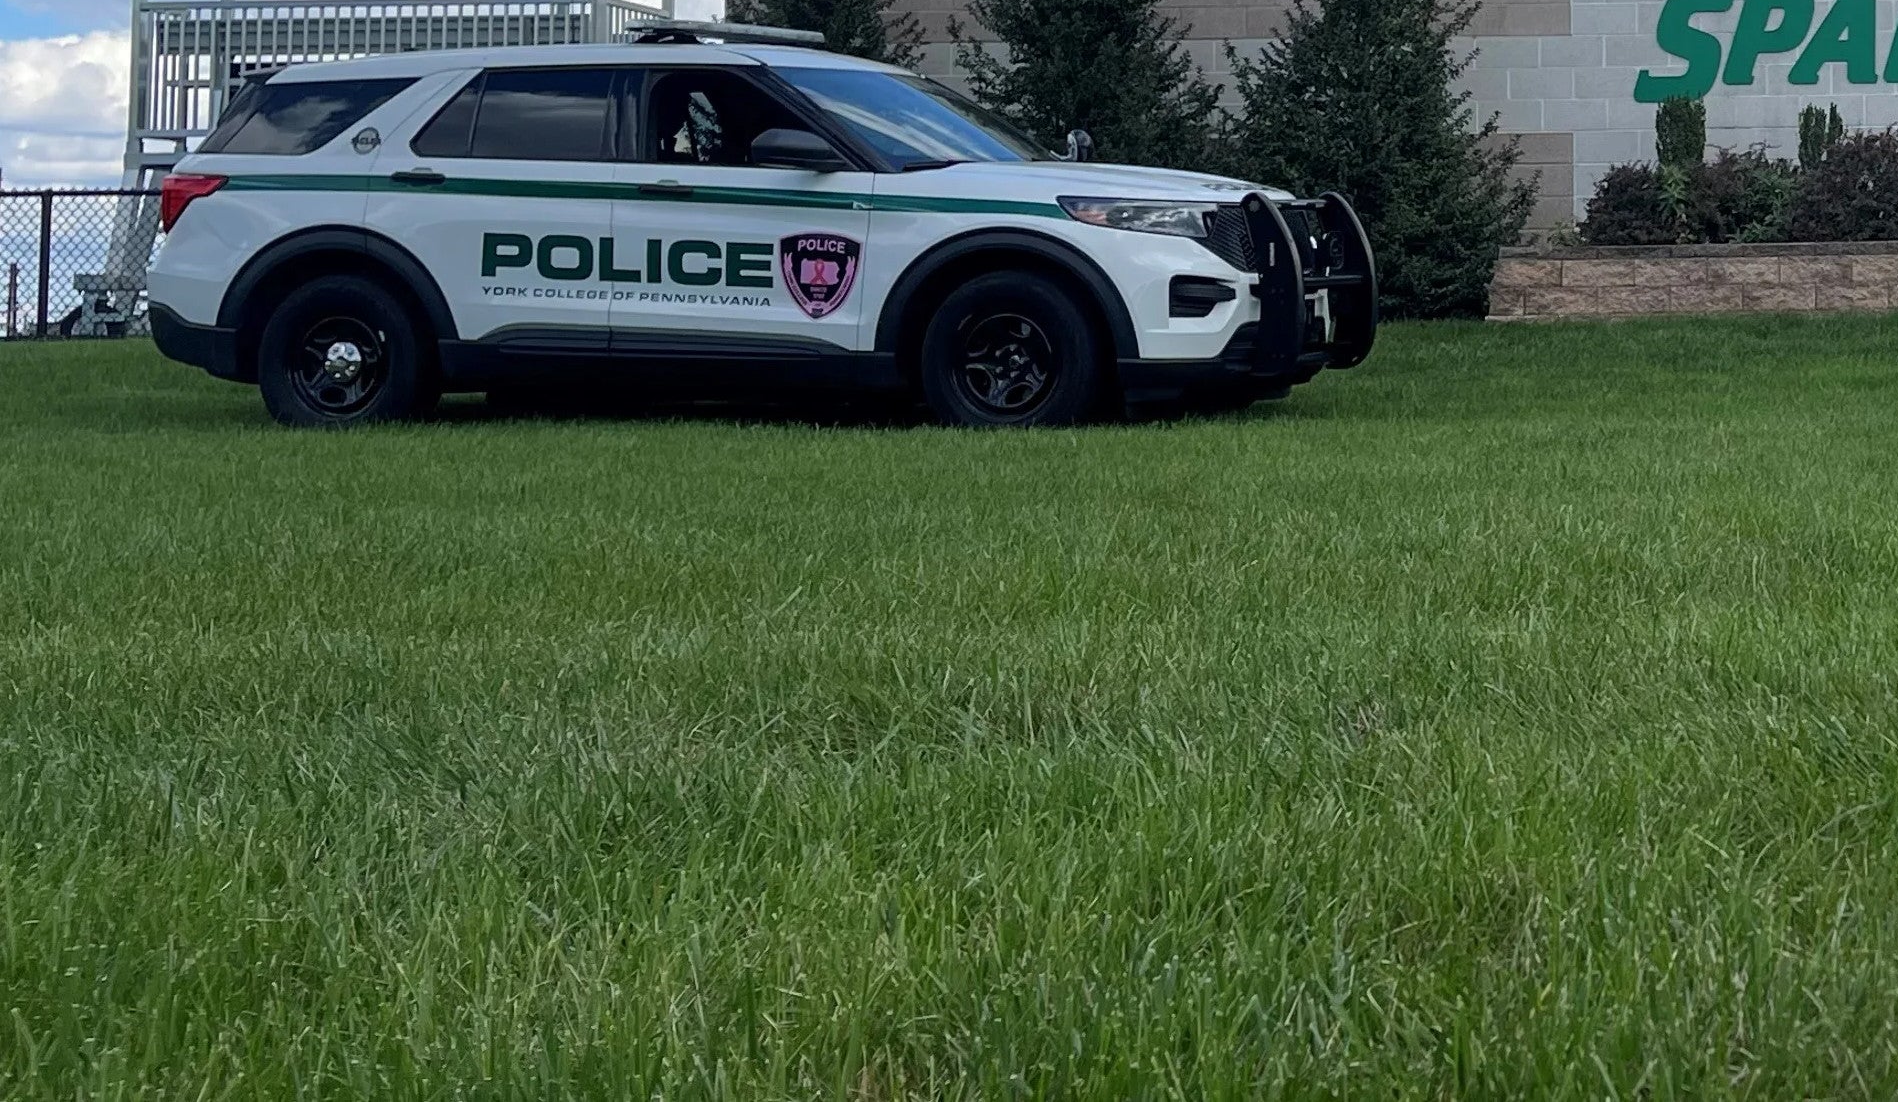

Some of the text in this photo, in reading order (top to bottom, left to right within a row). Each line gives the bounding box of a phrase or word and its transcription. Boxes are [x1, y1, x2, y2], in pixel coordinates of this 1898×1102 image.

[797, 239, 846, 254] POLICE
[481, 232, 774, 288] POLICE
[482, 286, 771, 307] YORK COLLEGE OF PENNSYLVANIA
